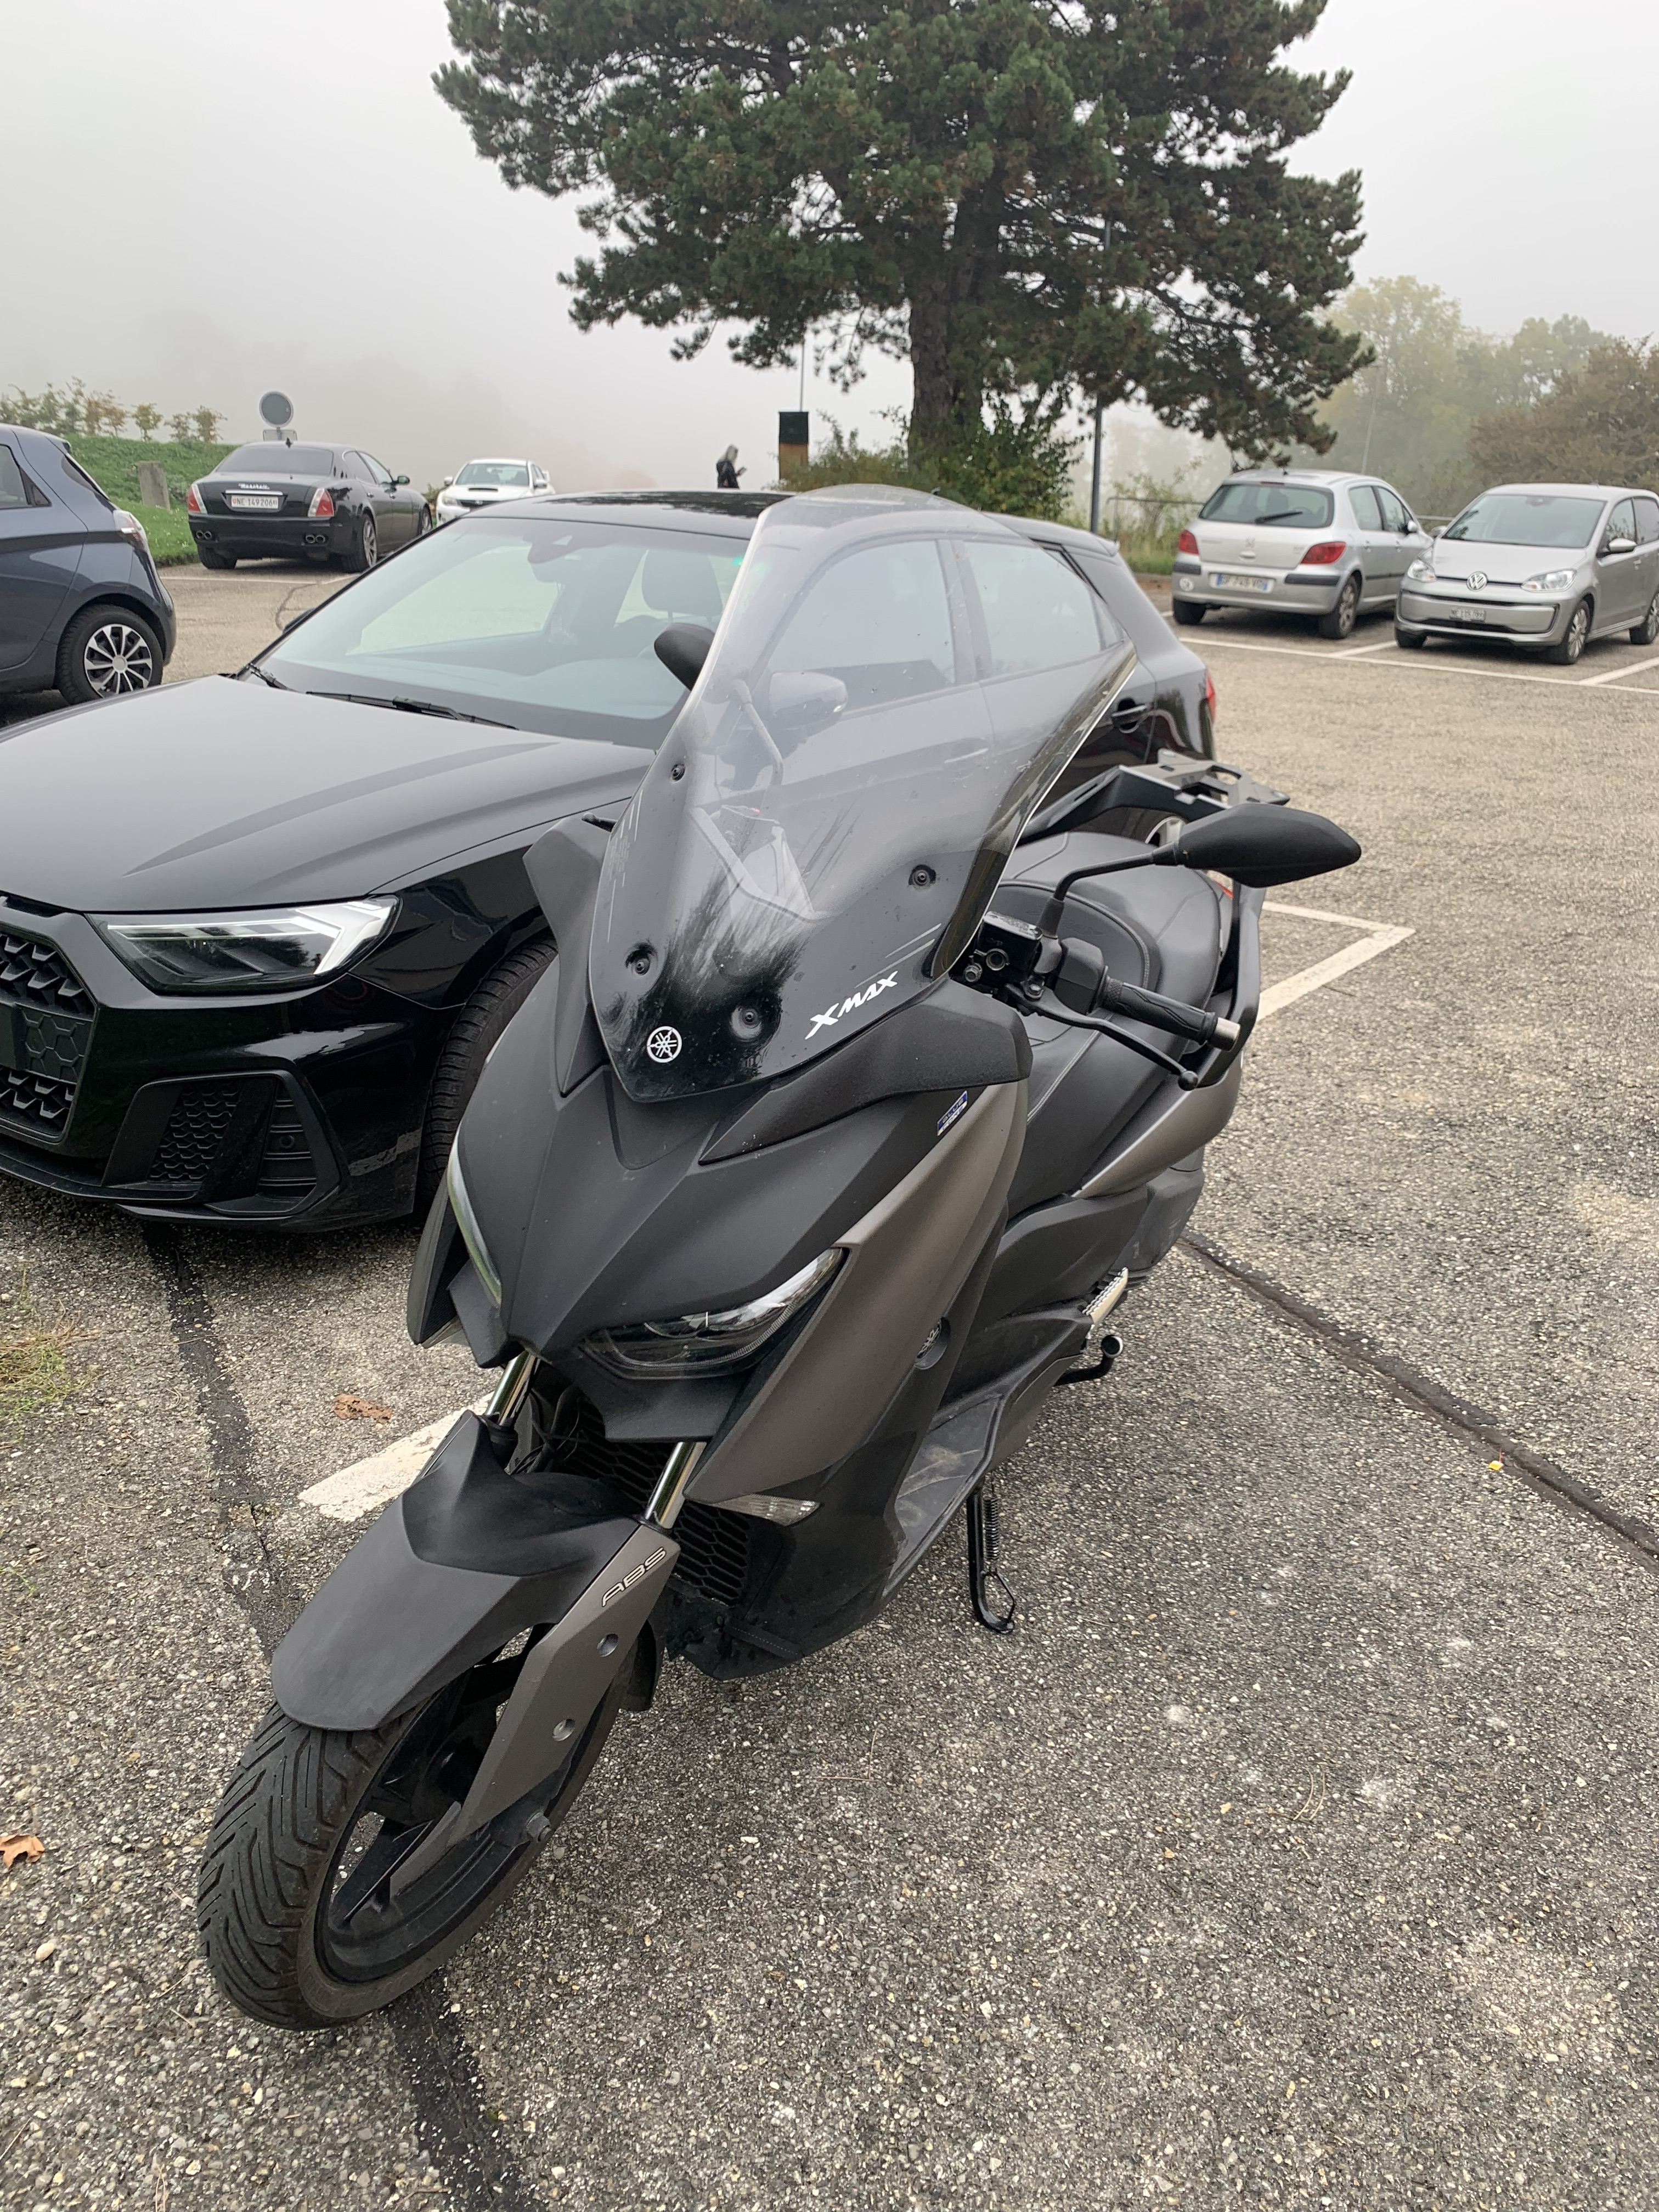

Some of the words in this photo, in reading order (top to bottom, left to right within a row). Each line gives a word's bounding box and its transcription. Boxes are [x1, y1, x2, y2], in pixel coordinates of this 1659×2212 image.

[237, 498, 245, 506] NE
[943, 1097, 964, 1124] BLUE
[602, 1547, 667, 1607] ABS
